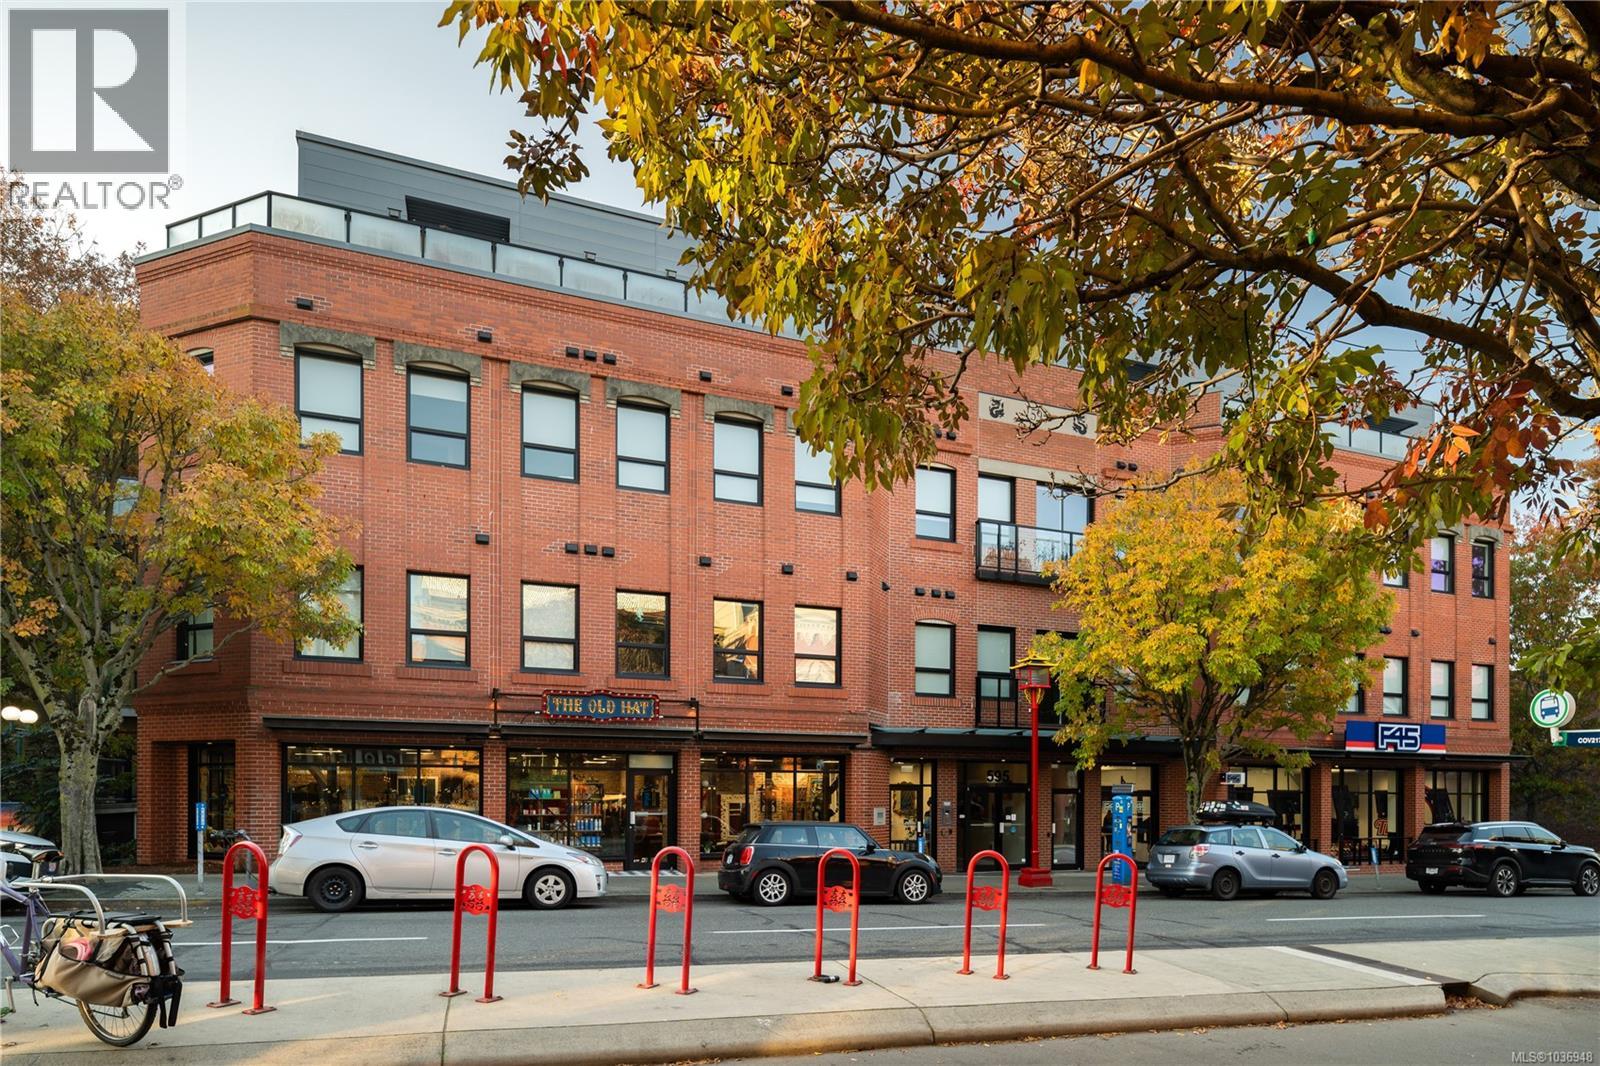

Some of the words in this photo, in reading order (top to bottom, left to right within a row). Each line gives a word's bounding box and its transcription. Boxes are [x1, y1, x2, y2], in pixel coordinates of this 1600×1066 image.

[552, 697, 582, 713] THE
[588, 699, 615, 714] OLD
[621, 700, 649, 715] HAT
[1378, 723, 1421, 751] F45
[986, 769, 1010, 782] 595
